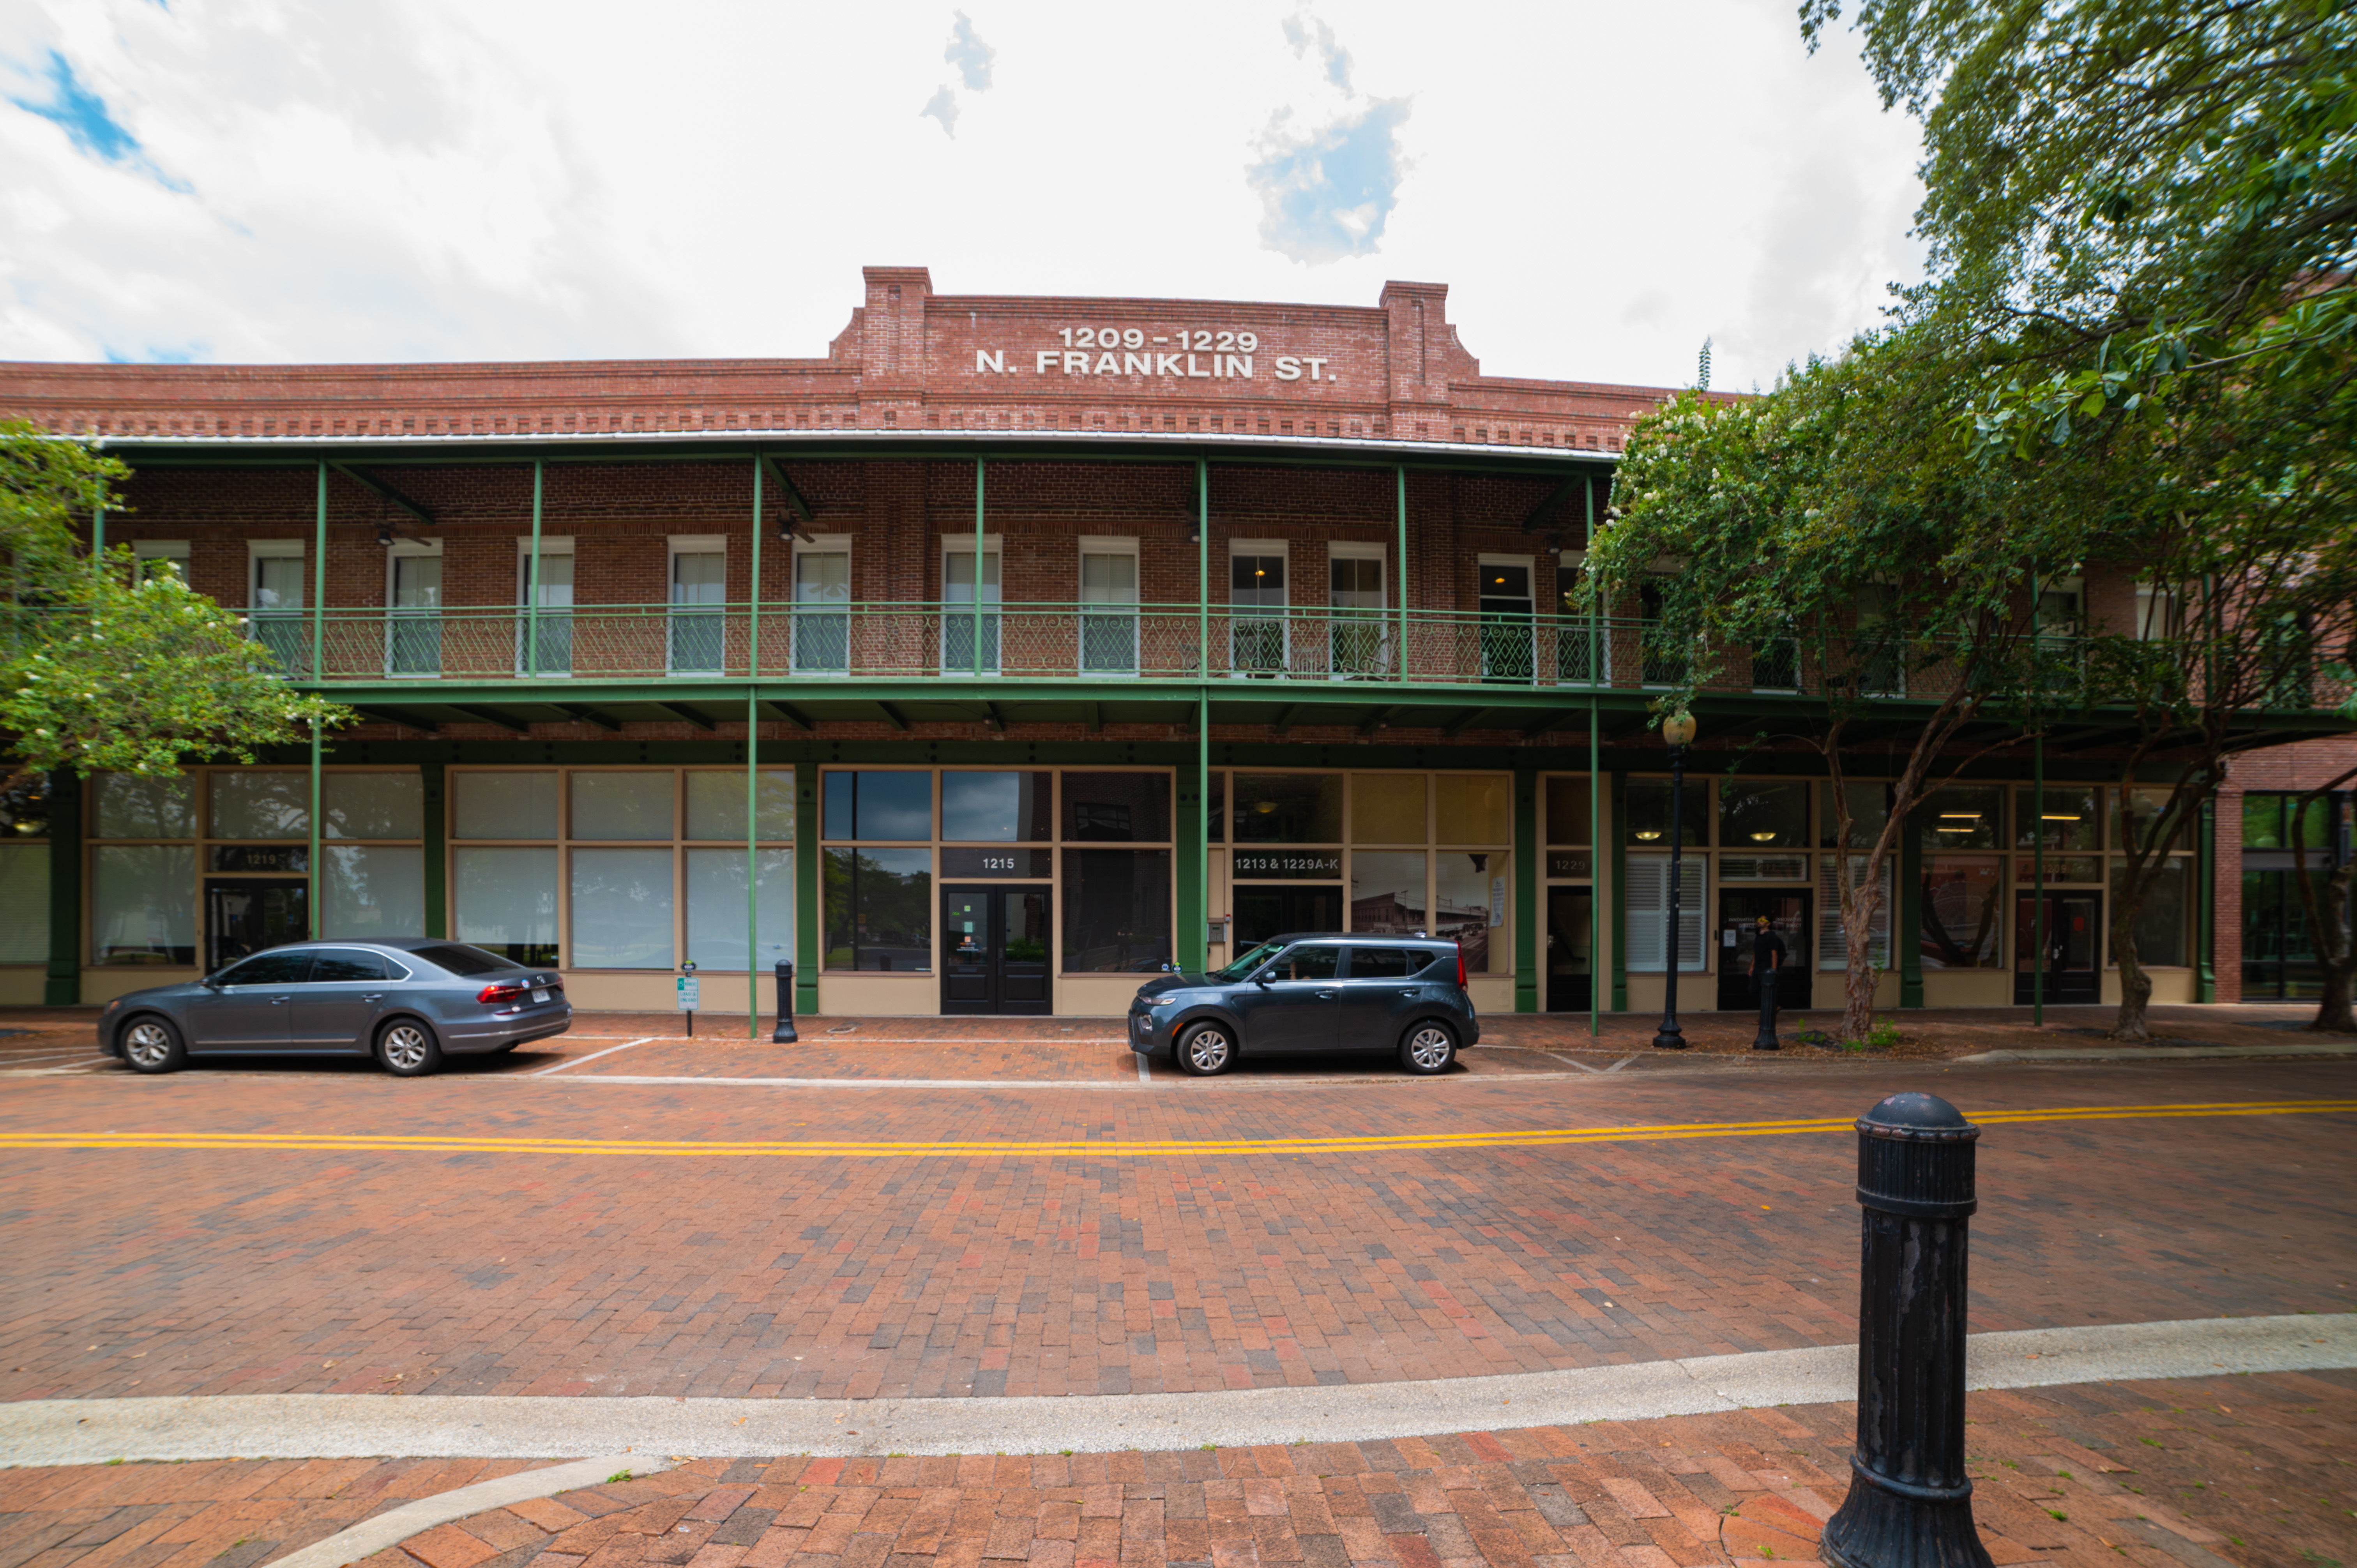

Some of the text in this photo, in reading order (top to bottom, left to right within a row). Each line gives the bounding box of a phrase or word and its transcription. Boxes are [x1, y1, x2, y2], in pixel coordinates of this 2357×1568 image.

[976, 350, 1337, 381] N. FRANKLIN ST.
[246, 855, 276, 864] 1219
[983, 858, 1014, 869] 1215
[1236, 858, 1338, 870] 1213 & 1229A-K
[1556, 860, 1585, 870] 1229
[2042, 864, 2067, 873] 1209
